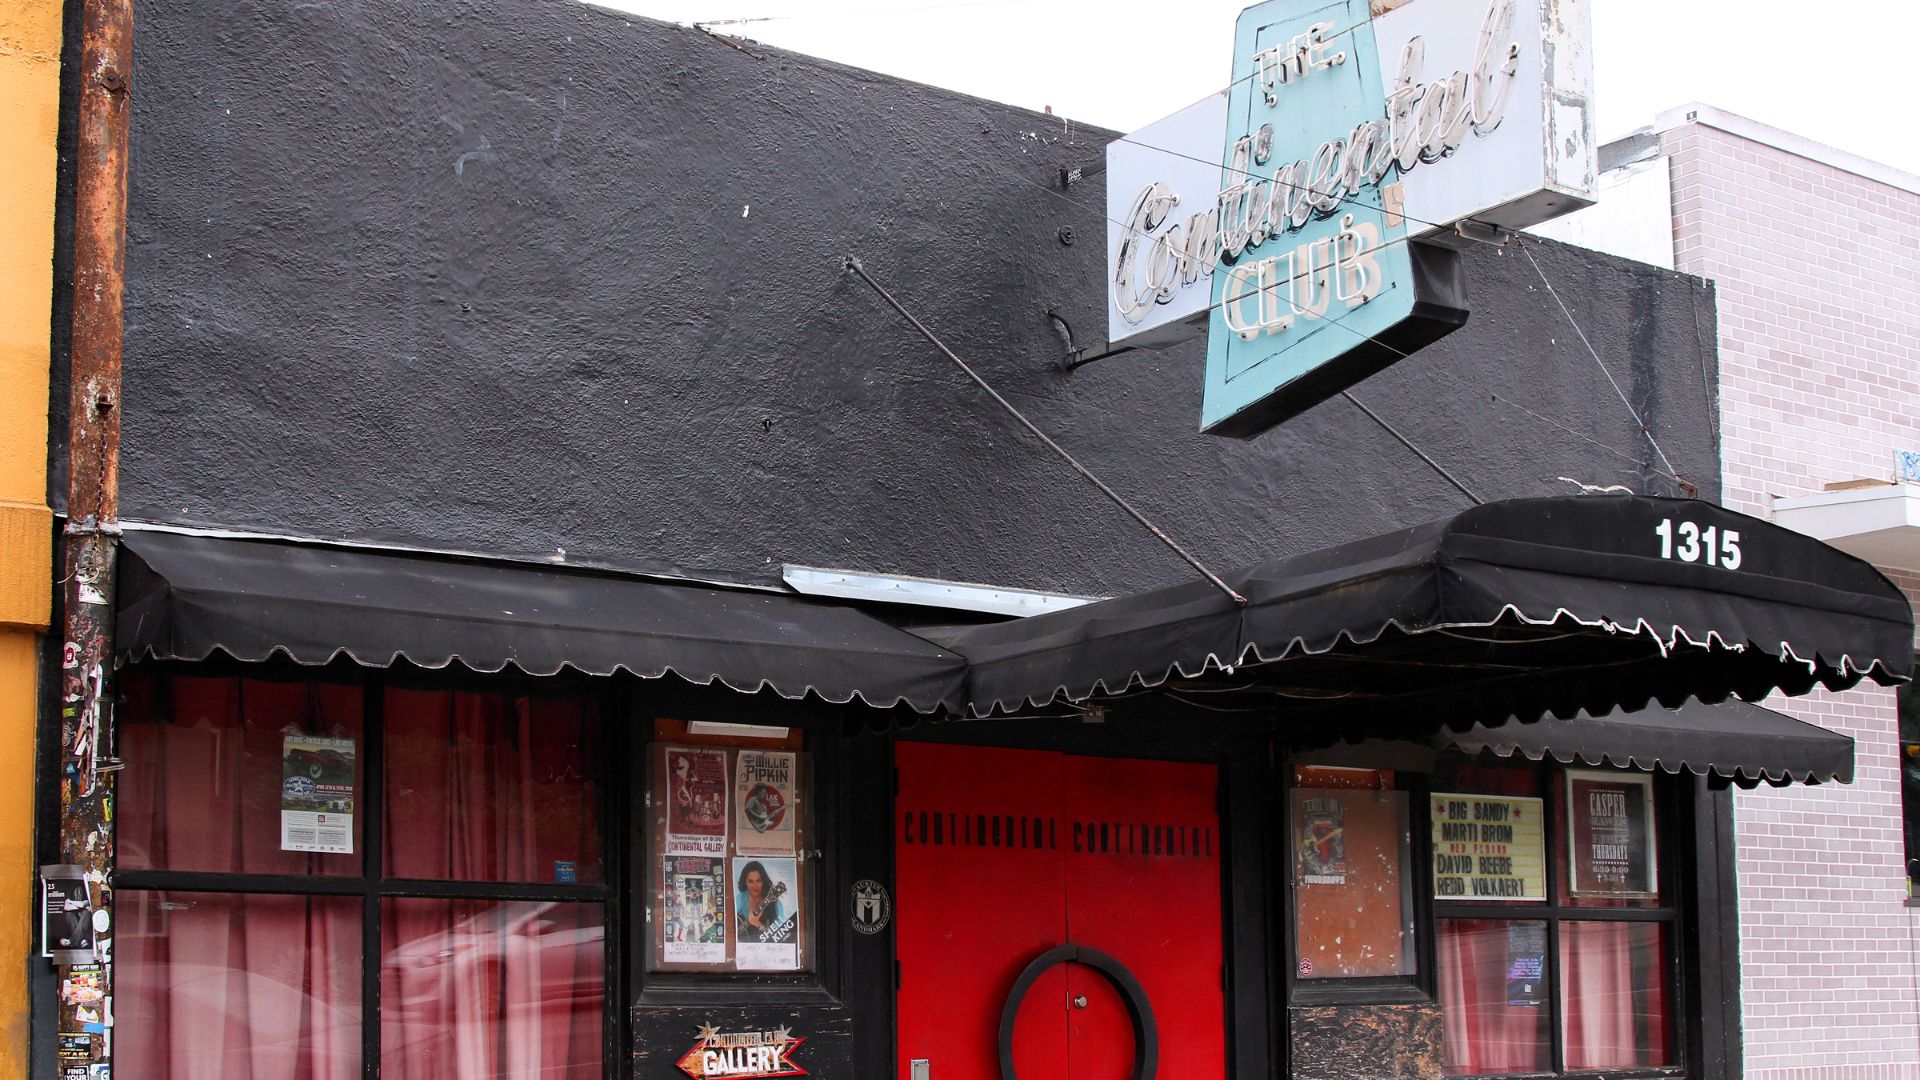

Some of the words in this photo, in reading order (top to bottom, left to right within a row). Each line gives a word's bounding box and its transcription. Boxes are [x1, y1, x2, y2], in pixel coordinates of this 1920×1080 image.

[1253, 20, 1346, 98] THE
[1113, 0, 1522, 325] Continental
[1222, 218, 1383, 340] CLUB
[1655, 518, 1742, 570] 1315
[755, 754, 789, 769] WILLIE
[741, 765, 788, 783] PIPKIN
[1449, 801, 1467, 819] BIG
[1474, 802, 1509, 822] SANDY
[1589, 793, 1626, 817] CASPER
[1442, 823, 1478, 842] MARTI
[1482, 825, 1513, 843] BROM
[668, 841, 702, 852] CONTINENTAL
[704, 842, 724, 852] GALLERY
[1592, 844, 1628, 859] THURSDAYS
[1436, 853, 1473, 874] DAVID
[1479, 856, 1513, 875] BEEBE
[1437, 877, 1465, 896] REDD
[1471, 878, 1525, 897] VOLKAERT
[772, 920, 795, 943] KING
[703, 1045, 785, 1076] GALLERY
